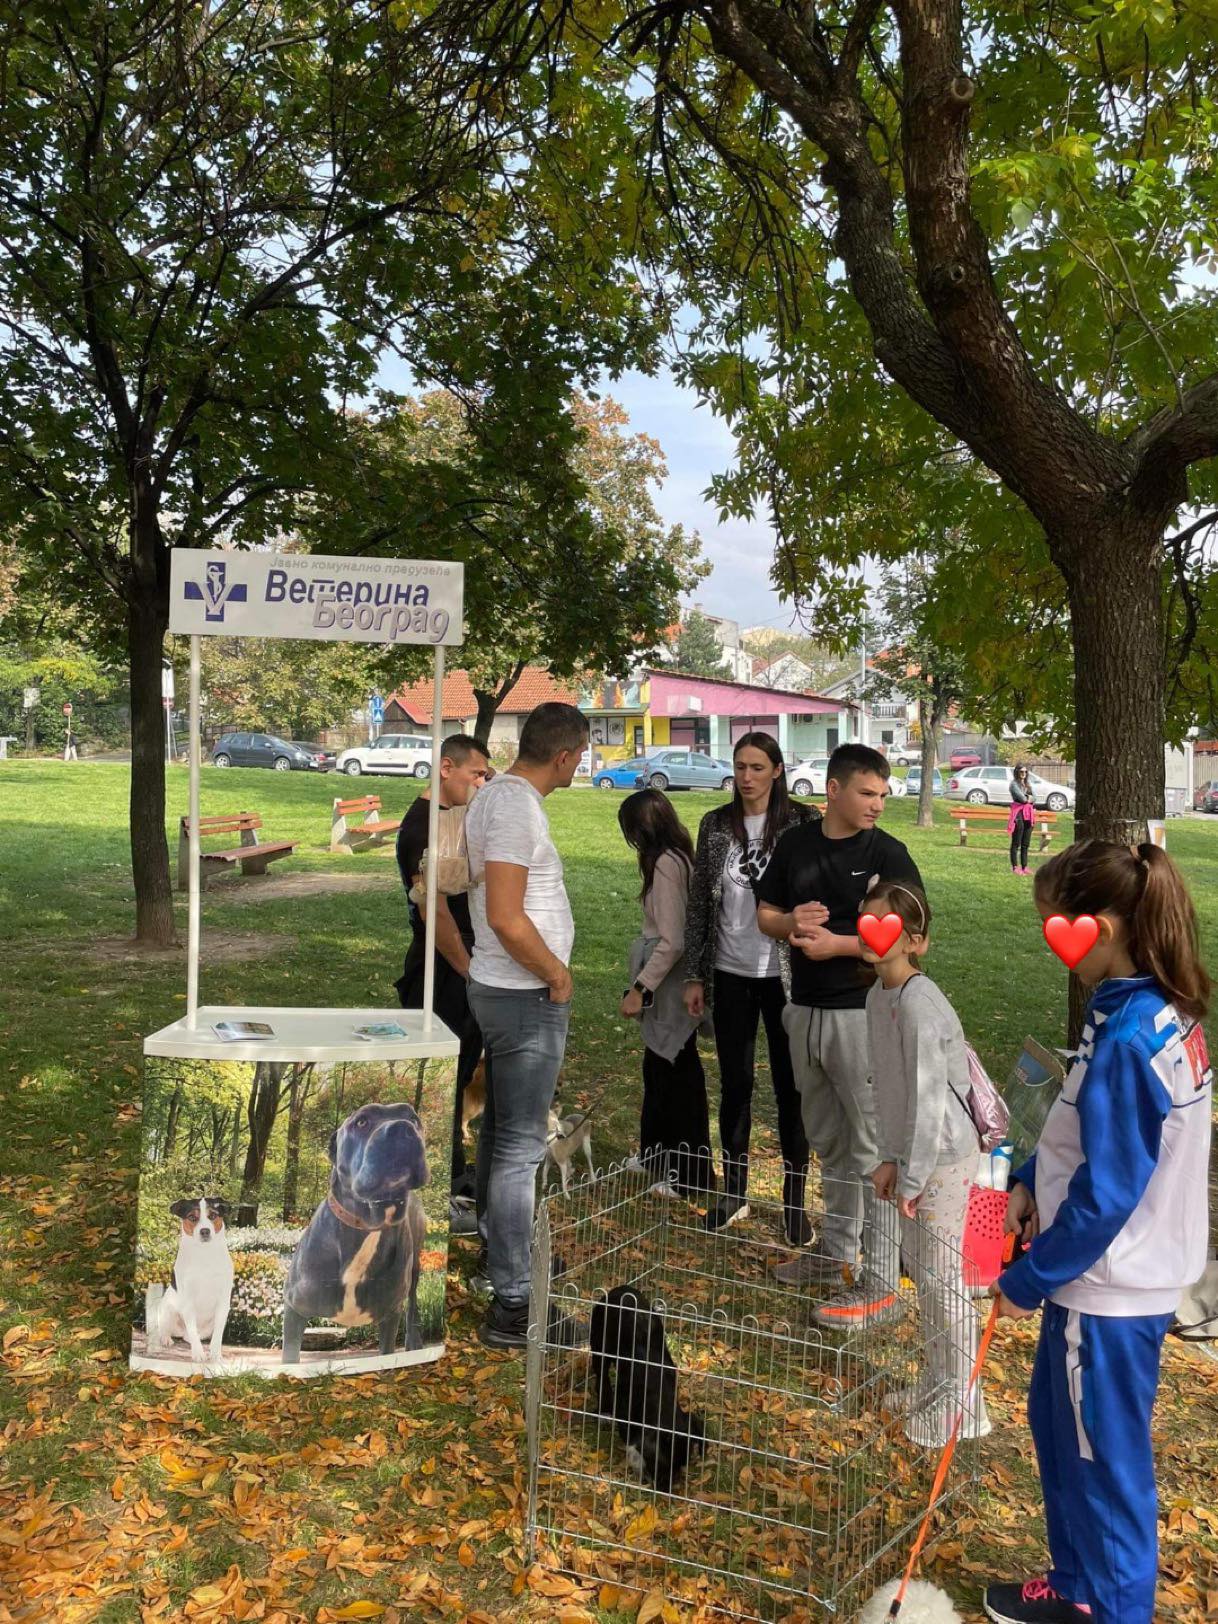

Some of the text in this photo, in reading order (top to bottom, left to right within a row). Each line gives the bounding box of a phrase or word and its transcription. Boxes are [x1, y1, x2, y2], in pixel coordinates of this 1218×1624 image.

[269, 556, 309, 569] Јавно
[311, 560, 383, 574] комунално
[264, 569, 431, 607] Ветерина
[312, 594, 451, 643] Београд
